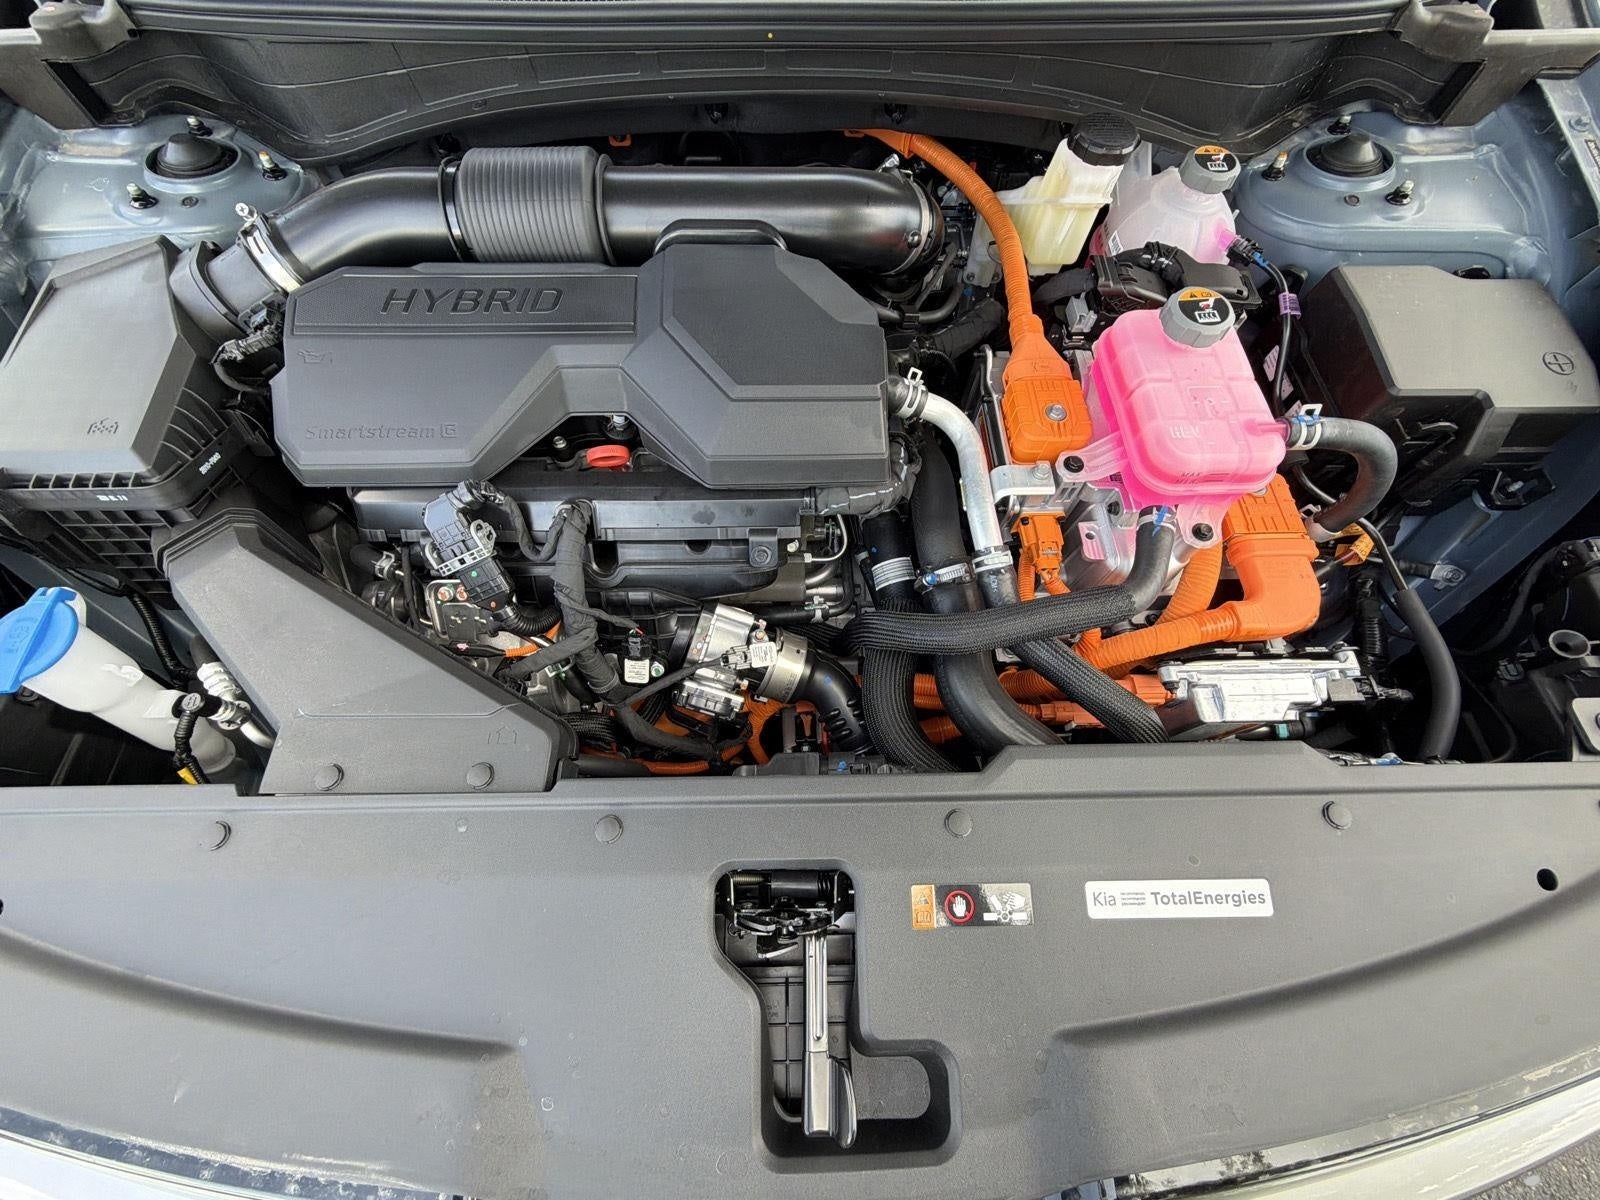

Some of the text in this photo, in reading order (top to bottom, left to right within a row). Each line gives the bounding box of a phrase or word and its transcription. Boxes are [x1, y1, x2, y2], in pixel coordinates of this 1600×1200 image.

[380, 287, 564, 315] HYBRID
[305, 424, 435, 440] Smartstream
[1092, 891, 1117, 907] Kia
[1150, 890, 1267, 908] TotalEnergies
